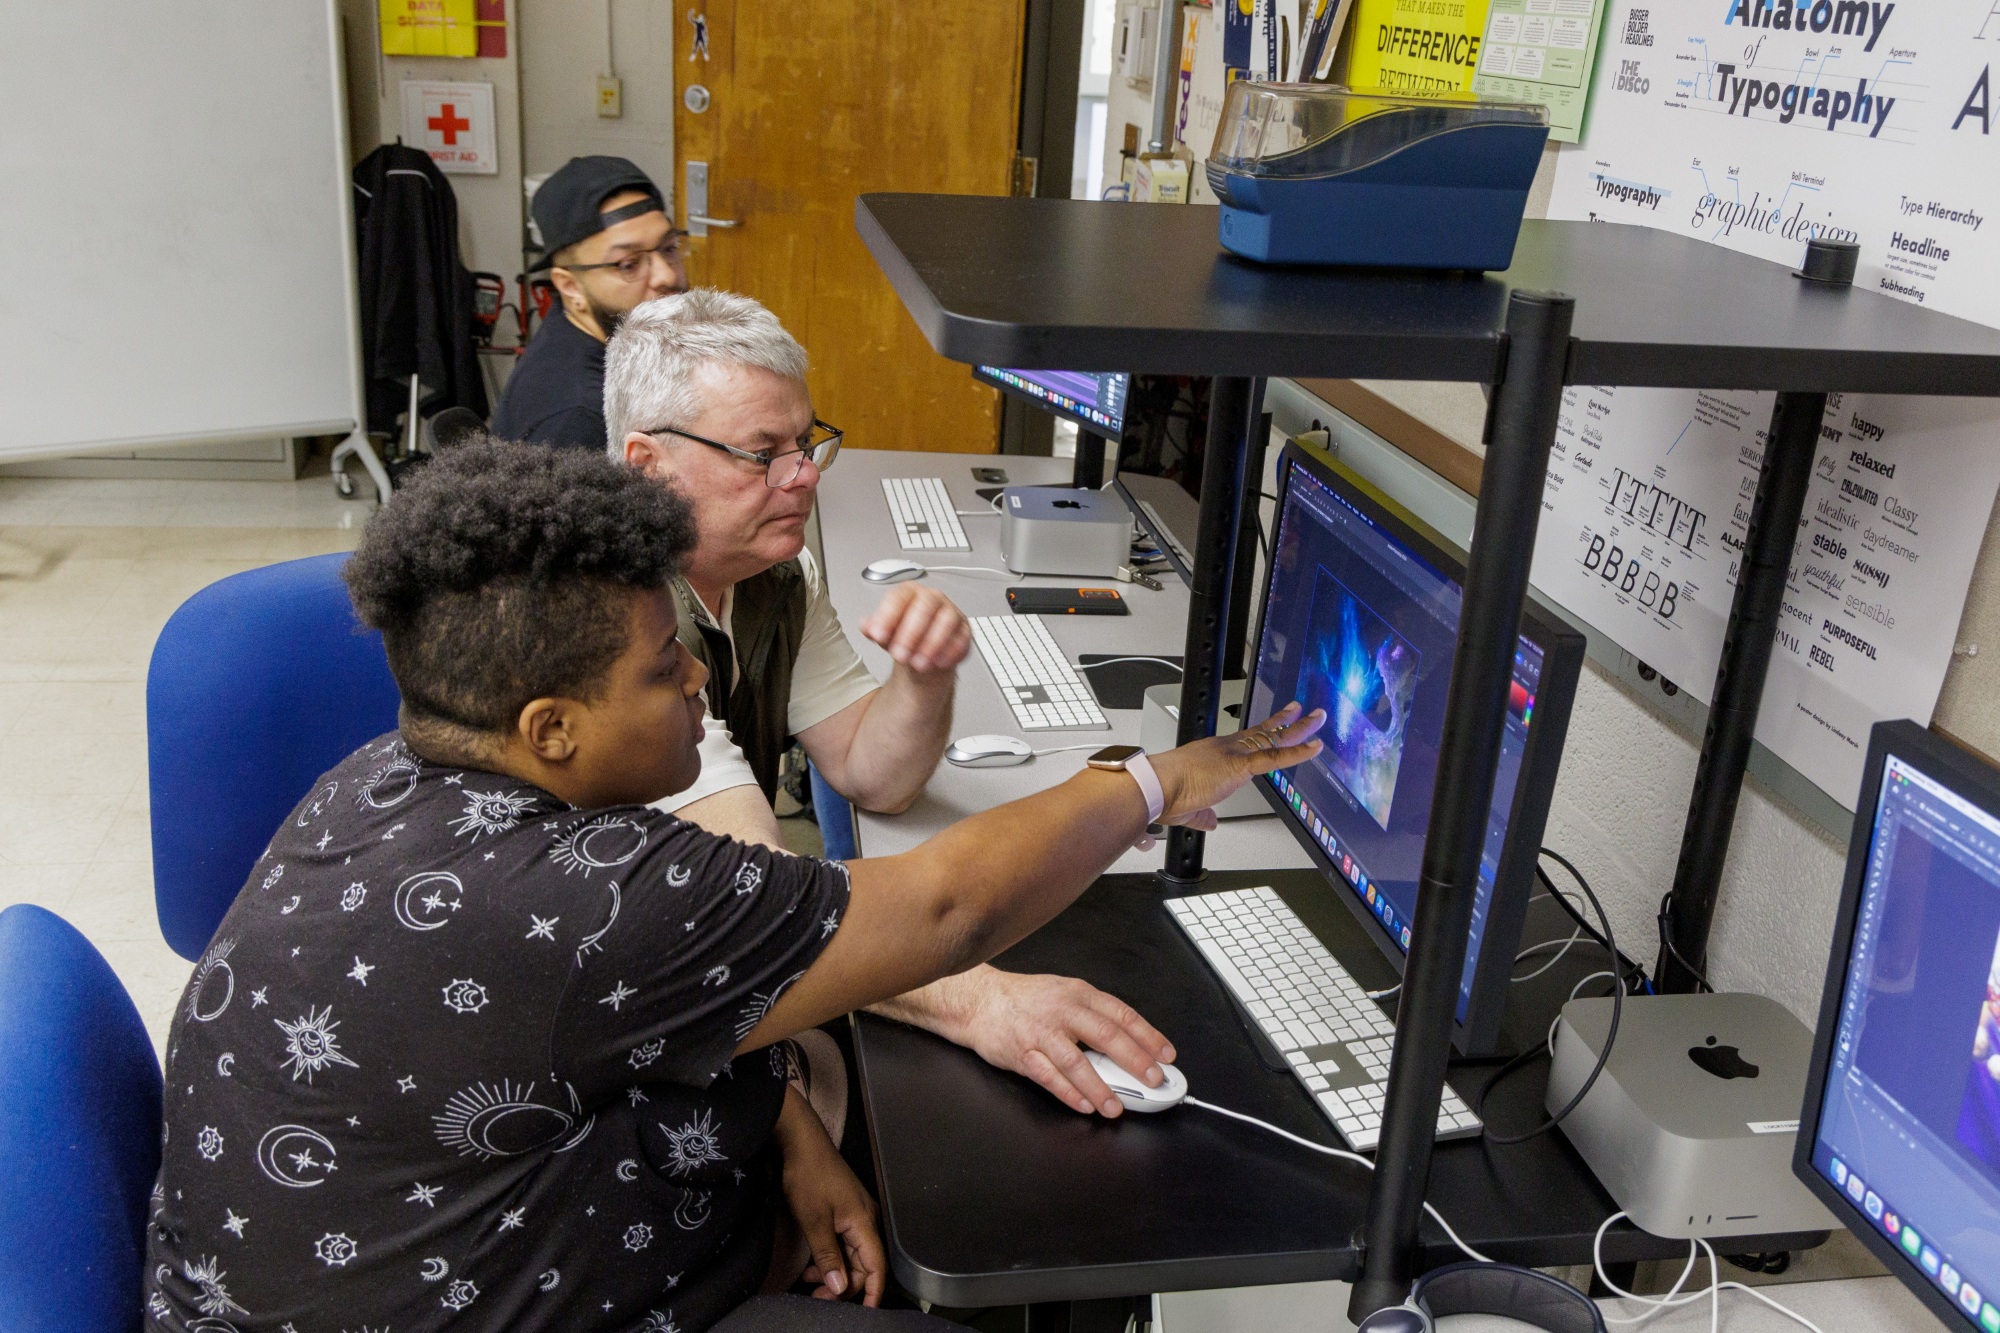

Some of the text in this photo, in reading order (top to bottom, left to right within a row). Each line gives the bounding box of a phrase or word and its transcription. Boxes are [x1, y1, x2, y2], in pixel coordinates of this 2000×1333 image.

[1418, 1, 1445, 16] MAKES
[1447, 3, 1465, 18] THE
[1629, 8, 1649, 21] BIGGER
[1625, 33, 1655, 47] HEADLINES
[1627, 21, 1649, 34] BOLDER
[1724, 0, 1896, 52] Anatomy
[1377, 24, 1480, 67] DIFFERENCE
[1743, 34, 1767, 69] of
[1805, 47, 1819, 58] Bowl
[1829, 45, 1842, 55] Arm
[1889, 48, 1917, 59] Aperture
[1174, 14, 1199, 146] FedEx
[1620, 59, 1641, 77] THE
[1616, 75, 1650, 95] DISCO
[1716, 63, 1896, 138] Typography
[1692, 157, 1702, 166] Ear
[1727, 165, 1740, 176] Serif
[1596, 174, 1662, 211] Typography
[1791, 171, 1826, 186] Ball Terminal
[1691, 192, 1778, 236] graphic
[1900, 195, 1984, 232] Type Hierarchy
[1890, 231, 1950, 262] Headline
[1880, 278, 1925, 302] Subheading
[1850, 411, 1885, 442] happy
[1818, 455, 1837, 477] flirty
[1849, 450, 1896, 479] relaxed
[1840, 478, 1879, 507] CALCULATED
[1817, 498, 1860, 531] idealistic
[1883, 496, 1919, 528] Classy
[1813, 533, 1847, 560] stable
[1863, 527, 1920, 564] daydreamer
[1802, 563, 1846, 591] youthful
[1852, 558, 1890, 589] sassy
[1845, 594, 1895, 630] sensible
[1822, 619, 1878, 661] PURPOSEFUL
[1809, 644, 1835, 673] REBEL
[1800, 705, 1813, 716] poster
[1812, 712, 1826, 725] design
[1831, 726, 1846, 740] Lindsay
[1846, 735, 1859, 749] Marsh
